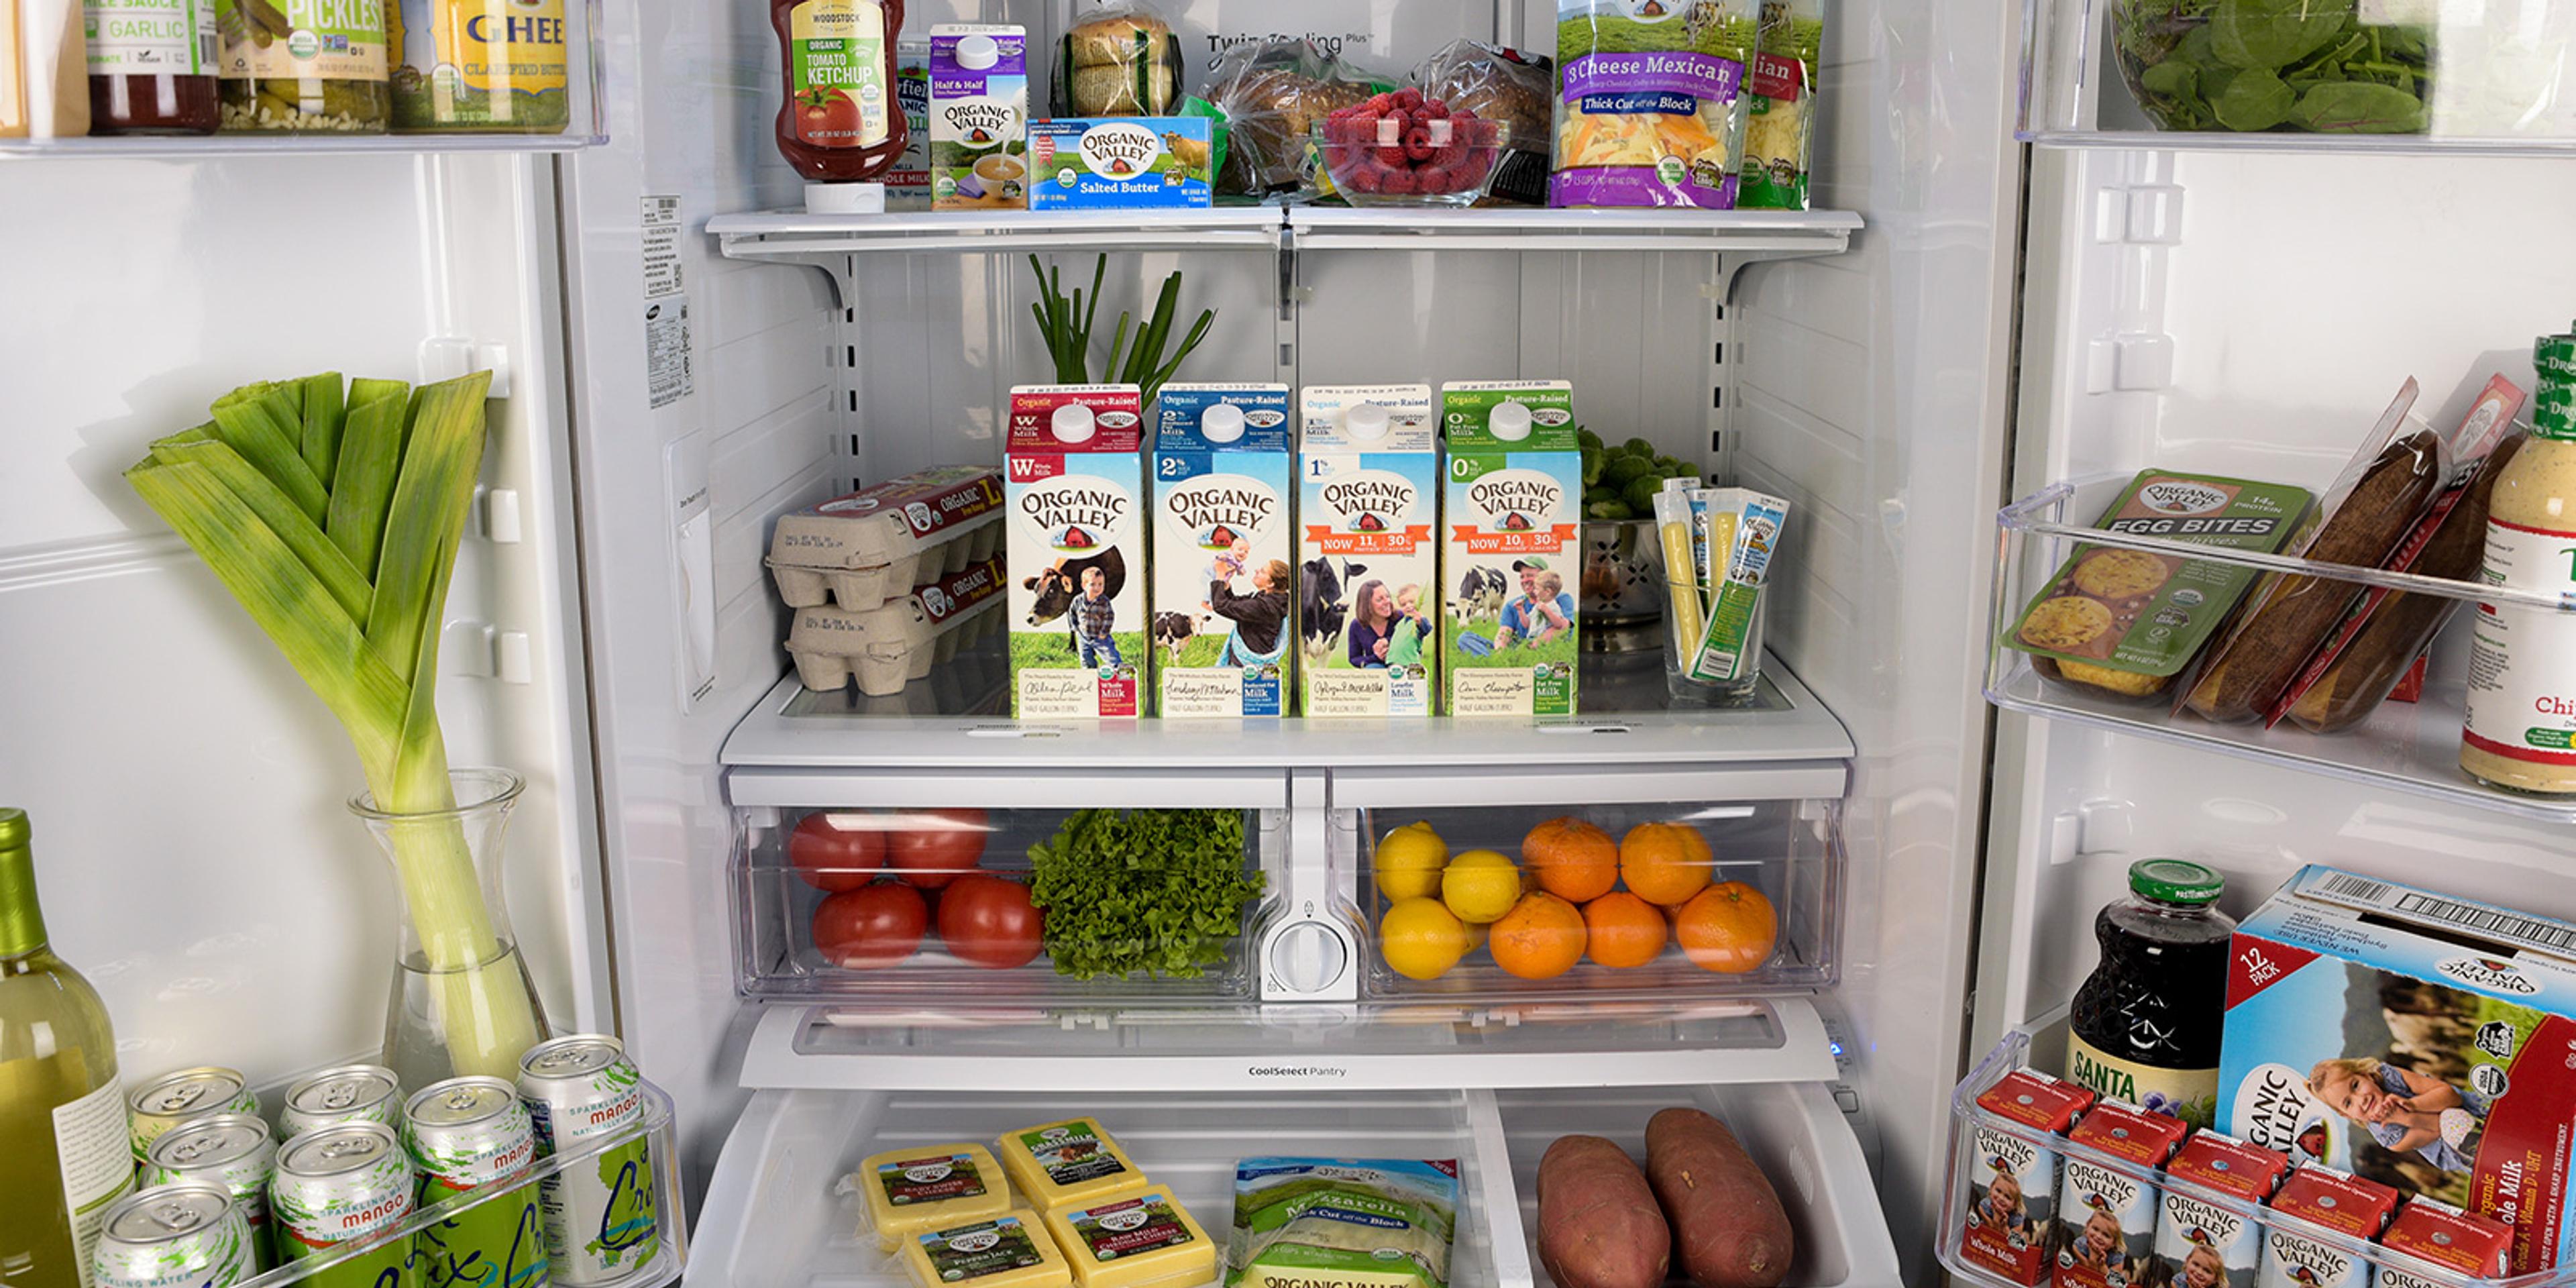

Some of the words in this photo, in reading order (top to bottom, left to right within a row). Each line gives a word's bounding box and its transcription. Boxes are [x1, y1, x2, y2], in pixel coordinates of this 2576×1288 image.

[286, 0, 380, 32] PICKLES
[813, 13, 861, 23] WOODSTOCK
[109, 20, 183, 38] GARLIC
[467, 15, 563, 43] GHEE
[809, 40, 843, 50] ORGANIC
[807, 54, 847, 66] TOMATO
[808, 67, 872, 85] KETCHUP
[1569, 67, 1577, 84] 3
[1578, 58, 1640, 79] Cheese
[1645, 56, 1730, 84] Mexican
[934, 80, 954, 89] Half
[964, 80, 983, 89] Half
[945, 105, 1010, 121] ORGANIC
[1585, 98, 1613, 109] Thick
[1615, 99, 1633, 109] Cut
[1658, 97, 1692, 111] Block
[953, 117, 1004, 130] VALLEY
[1083, 131, 1155, 151] ORGANIC
[1091, 149, 1146, 162] VALLEY
[1080, 182, 1119, 193] Salted
[1122, 182, 1160, 193] Butter
[1017, 398, 1052, 407] Organic
[1073, 397, 1137, 407] Pasture-Raised
[1165, 396, 1198, 406] Organic
[1221, 396, 1285, 405] Pasture-Raised
[1307, 400, 1341, 411] Organic
[1365, 398, 1429, 407] Pasture-Raised
[1448, 395, 1481, 405] Organic
[1505, 395, 1568, 404] Pasture-Raised
[1016, 416, 1036, 425] W
[1012, 459, 1035, 476] W
[941, 488, 981, 512] ORGANIC
[979, 479, 1002, 505] L
[1325, 482, 1412, 503] ORGANIC
[1471, 482, 1558, 502] ORGANIC
[2148, 485, 2224, 503] ORGANIC
[2153, 492, 2208, 506] VALLEY
[1022, 490, 1127, 515] ORGANIC
[1169, 490, 1273, 515] ORGANIC
[1334, 498, 1402, 517] VALLEY
[1481, 498, 1550, 516] VALLEY
[2235, 502, 2282, 514] PROTEIN
[1034, 508, 1116, 531] VALLEY
[1181, 508, 1263, 529] VALLEY
[2112, 519, 2174, 535] EGG
[2180, 519, 2274, 533] BITES
[1324, 539, 1353, 550] NOW
[1470, 539, 1499, 549] NOW
[953, 569, 988, 596] ORGANIC
[987, 560, 1006, 587] L
[1102, 689, 1125, 698] Milk
[1244, 689, 1269, 698] Milk
[1391, 689, 1414, 698] Milk
[1536, 687, 1560, 696] Milk
[2299, 936, 2339, 951] NEVER
[2240, 947, 2268, 973] 12
[2249, 962, 2280, 985] PACK
[2440, 964, 2535, 994] ORGANIC
[2460, 959, 2528, 985] VALLEY
[1248, 1067, 1307, 1076] CoolSelect
[1309, 1067, 1347, 1077] Pantry
[2075, 1051, 2136, 1104] SANTA
[570, 1090, 626, 1116] SPARKLING
[2249, 1071, 2287, 1146] GANIC
[1977, 1128, 2035, 1161] ORGANIC
[1981, 1140, 2026, 1170] VALLEY
[2526, 1149, 2542, 1172] UHT
[2068, 1162, 2137, 1198] ORGANIC
[2499, 1161, 2522, 1198] Milk
[2524, 1177, 2538, 1187] D
[2549, 1173, 2561, 1197] SHARP
[2074, 1175, 2129, 1206] VALLEY
[319, 1194, 386, 1217] SPARKLING
[1285, 1194, 1407, 1218] Mzzarella
[2518, 1184, 2537, 1224] Vitamin
[2548, 1198, 2557, 1206] A
[1318, 1209, 1341, 1218] Cut
[1370, 1217, 1404, 1227] Block
[2167, 1195, 2241, 1232] ORGANIC
[2497, 1201, 2516, 1225] ole
[2546, 1207, 2557, 1226] WITH
[2173, 1208, 2232, 1240] VALLEY
[1099, 1238, 1142, 1250] CHEDDAR
[1143, 1229, 1177, 1241] CHEESE
[2518, 1232, 2530, 1242] A
[2544, 1228, 2554, 1246] OPEN
[954, 1255, 989, 1265] PEPPER
[990, 1249, 1014, 1258] JACK
[1970, 1236, 1996, 1256] Whole
[1996, 1248, 2017, 1265] Milk
[2271, 1233, 2348, 1272] ORGANIC
[2514, 1242, 2530, 1271] Grade
[2542, 1247, 2551, 1261] NOT
[2276, 1248, 2338, 1284] VALLEY
[150, 1272, 193, 1287] WATER
[1265, 1276, 1343, 1288] ORGANIC
[1348, 1280, 1408, 1288] VALLEY
